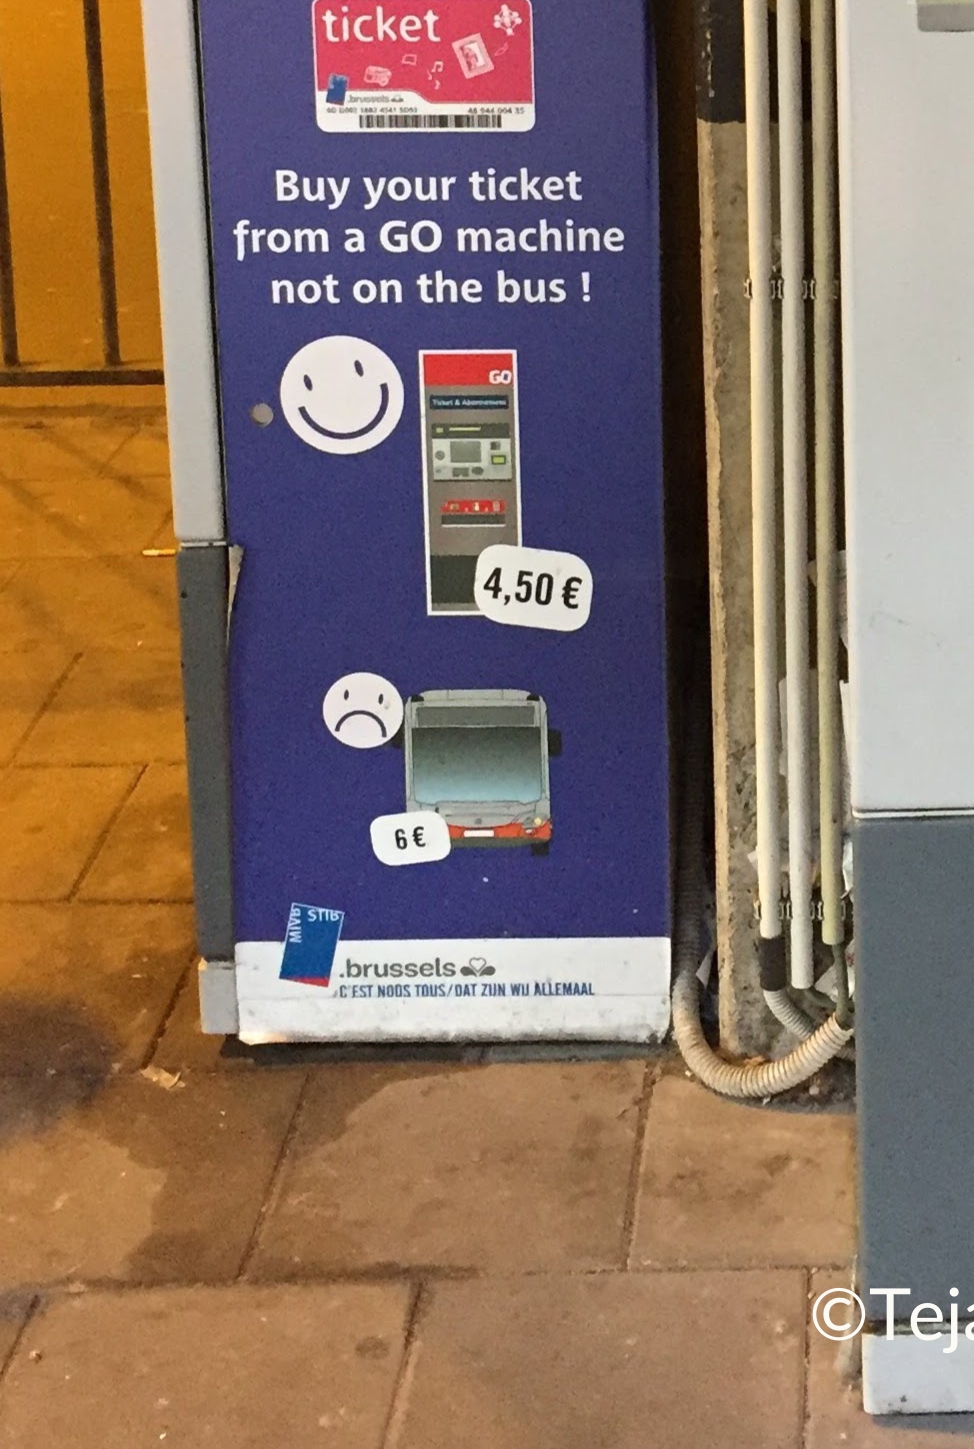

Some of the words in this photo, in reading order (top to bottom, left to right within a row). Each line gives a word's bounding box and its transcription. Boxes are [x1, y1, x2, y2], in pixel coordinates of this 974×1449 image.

[322, 6, 441, 42] ticket
[275, 170, 350, 209] Buy
[364, 176, 455, 209] your
[469, 168, 582, 200] ticket
[233, 220, 330, 261] from
[344, 228, 365, 253] a
[380, 220, 442, 253] GO
[457, 219, 625, 252] machine
[272, 275, 339, 304] not
[353, 279, 402, 304] on
[417, 271, 482, 303] the
[498, 271, 567, 303] bus
[582, 272, 591, 302] !
[489, 370, 512, 384] GO
[484, 568, 553, 606] 4,50
[562, 577, 582, 609] €
[395, 829, 407, 849] 6
[412, 826, 426, 847] €
[340, 957, 456, 978] .brussels
[340, 984, 372, 998] C'EST
[482, 983, 505, 996] ZIJN
[511, 983, 529, 996] WIJ
[534, 982, 595, 996] ALLEMAAL
